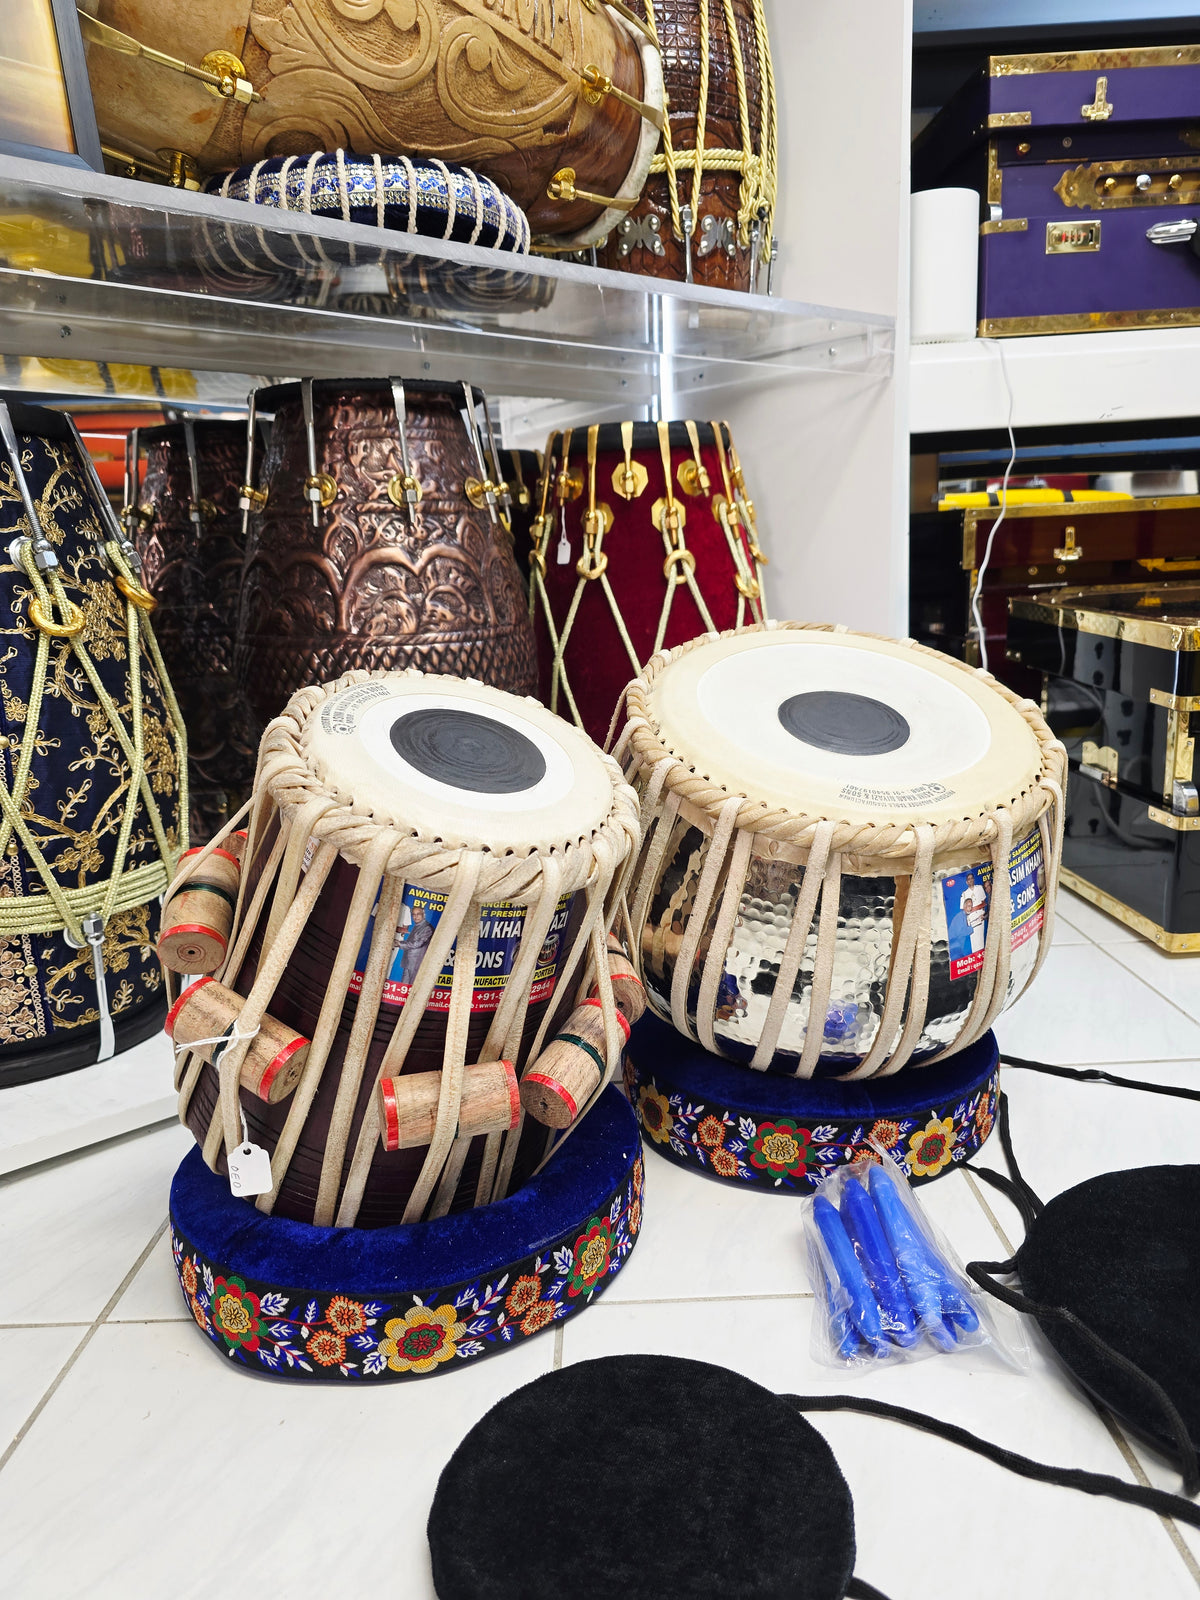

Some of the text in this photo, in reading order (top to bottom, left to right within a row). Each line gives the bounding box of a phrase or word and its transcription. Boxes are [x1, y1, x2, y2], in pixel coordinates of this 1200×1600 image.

[408, 888, 450, 902] AWARDE
[1017, 882, 1036, 910] SONS
[413, 899, 428, 908] BY
[490, 910, 528, 918] PRESIDE
[491, 920, 523, 939] KHA
